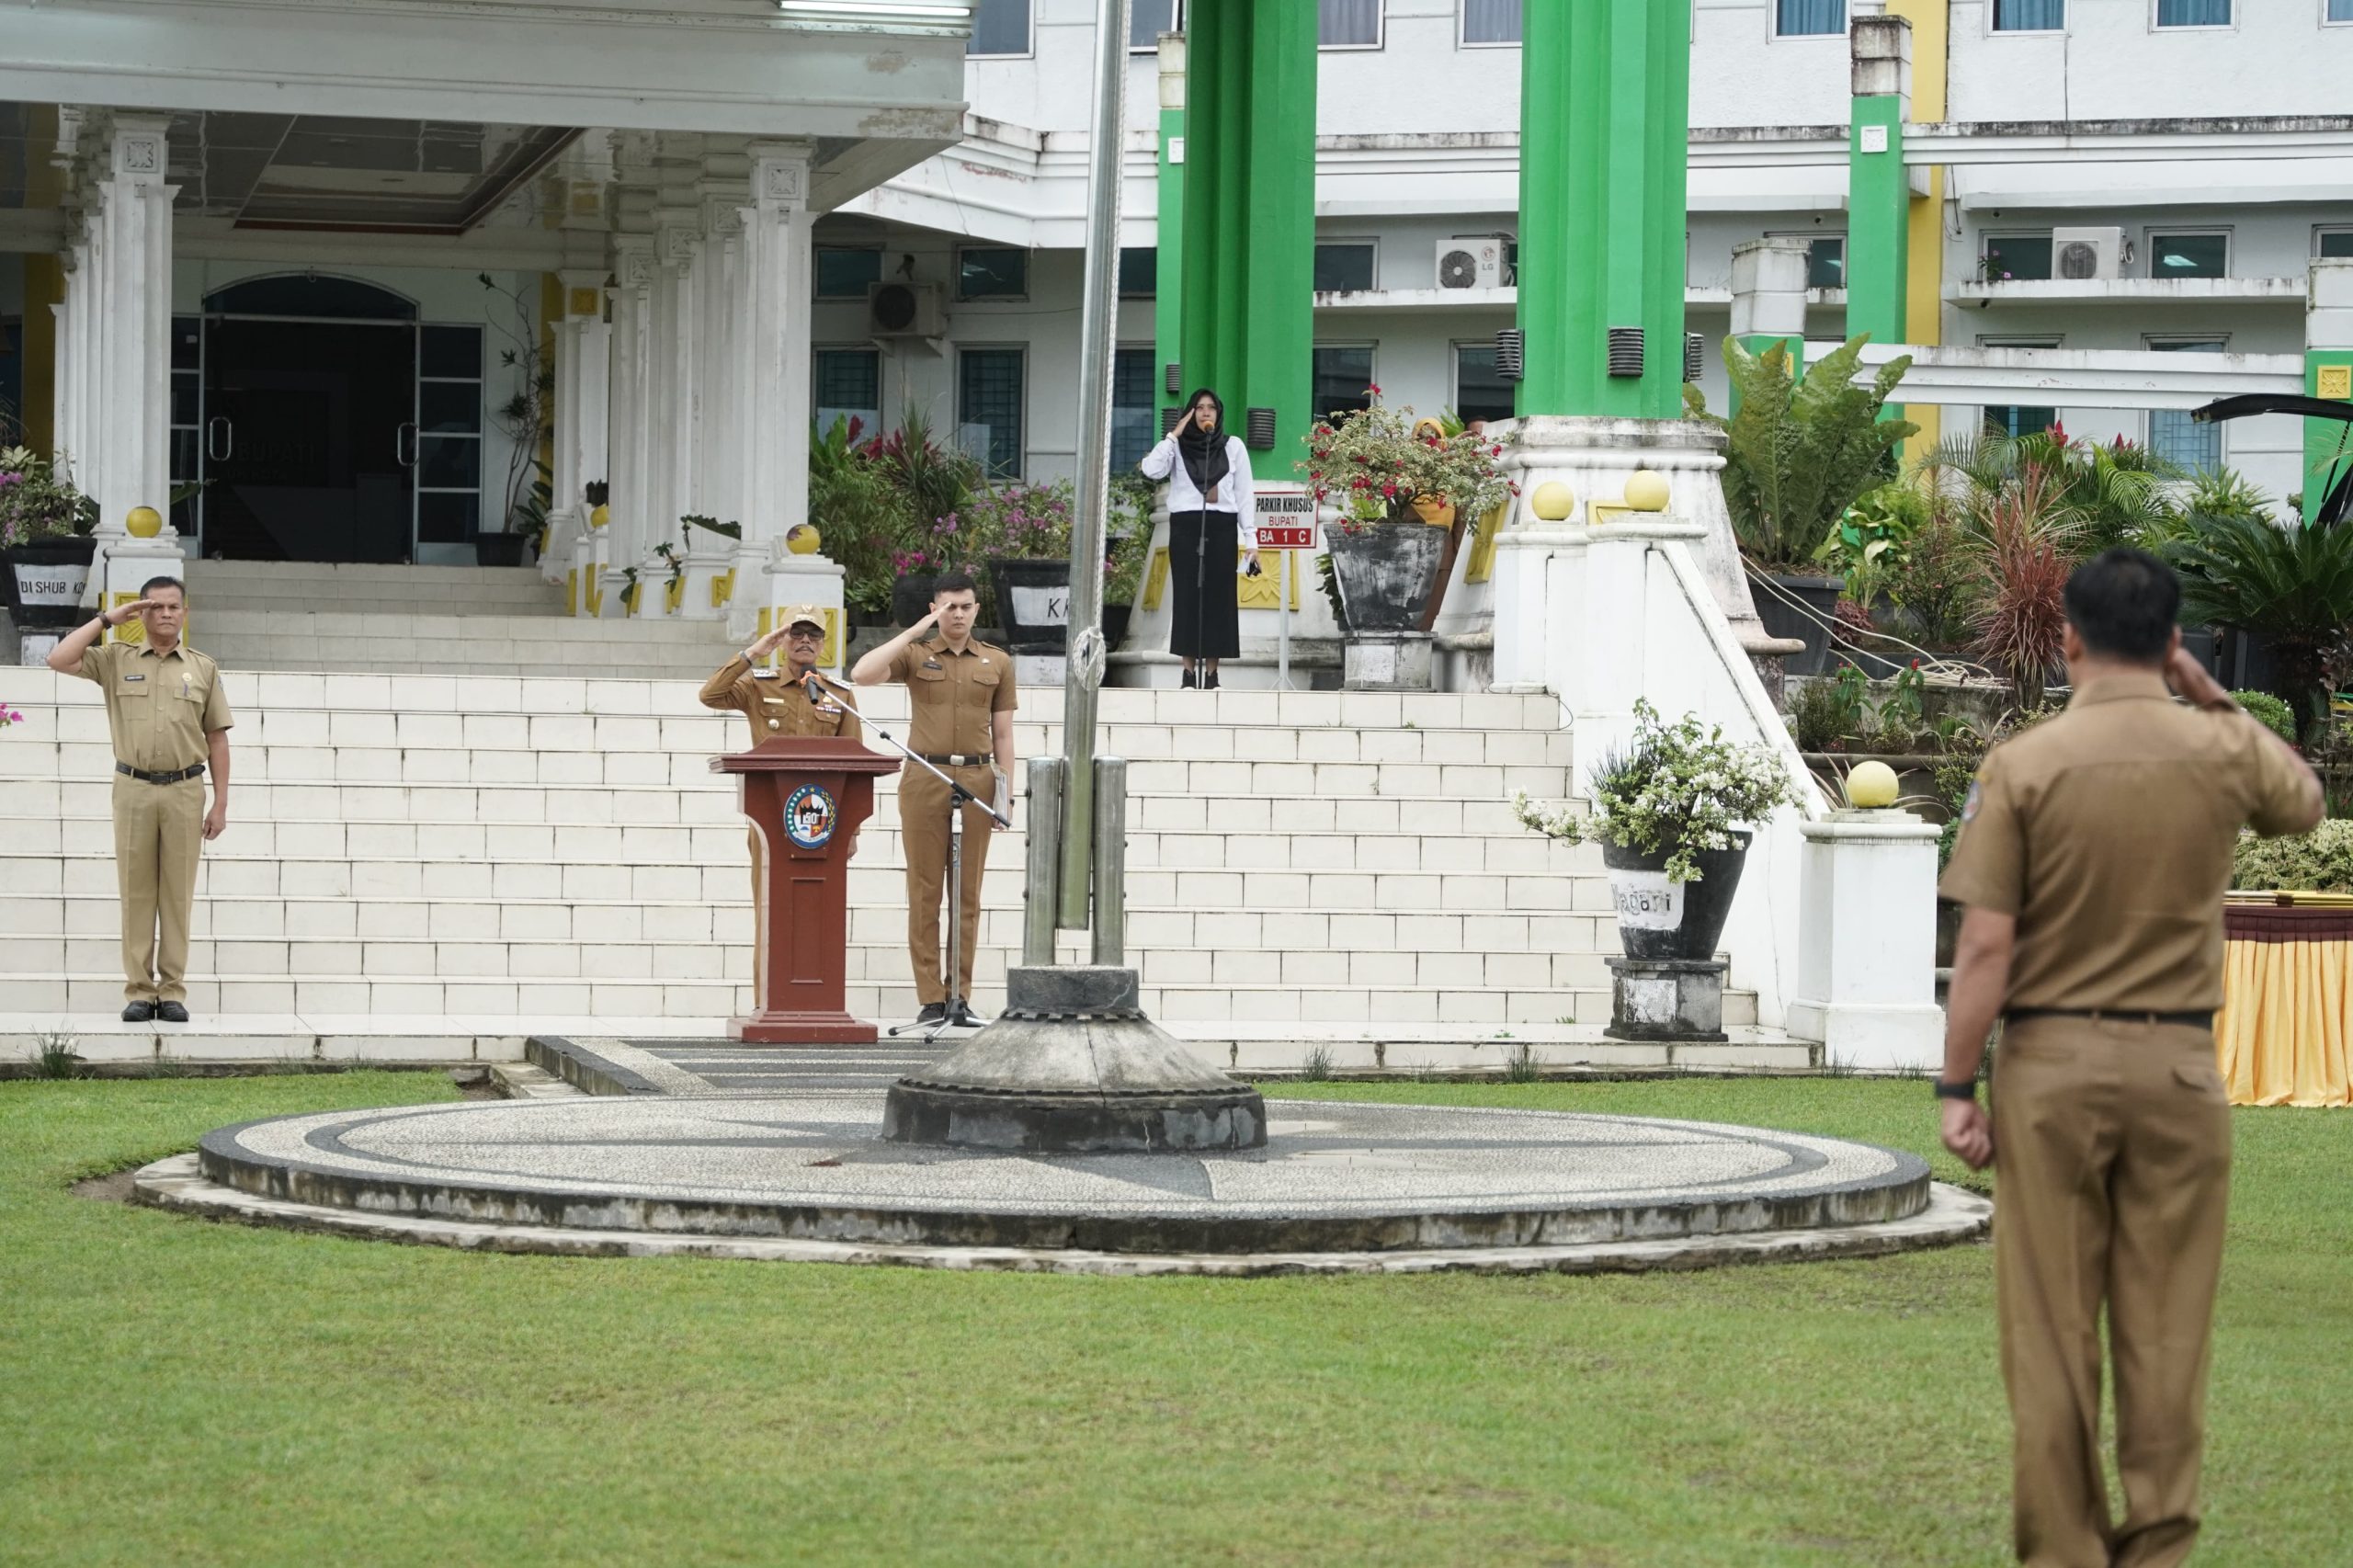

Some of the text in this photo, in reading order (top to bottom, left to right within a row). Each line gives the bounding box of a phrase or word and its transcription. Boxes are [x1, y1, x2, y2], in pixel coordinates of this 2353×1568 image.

[1256, 497, 1313, 513] PARKIR KHUSUS
[1268, 516, 1298, 527] BUPATI
[1259, 529, 1306, 543] BA 1 C
